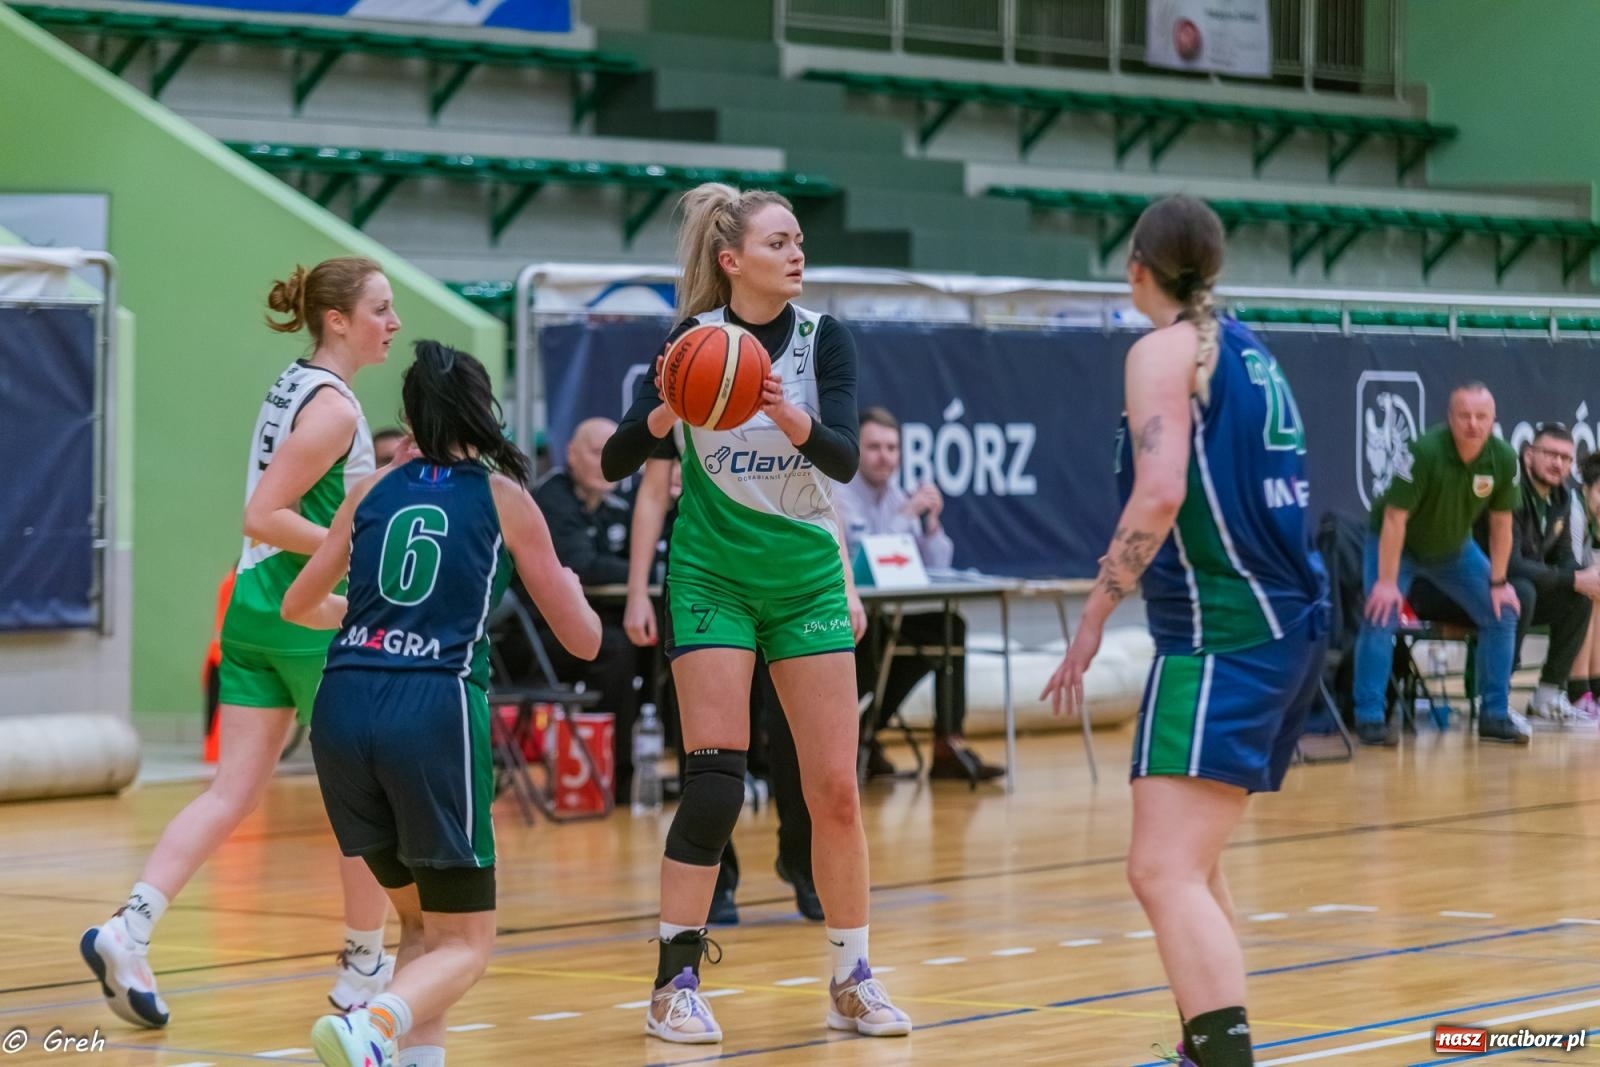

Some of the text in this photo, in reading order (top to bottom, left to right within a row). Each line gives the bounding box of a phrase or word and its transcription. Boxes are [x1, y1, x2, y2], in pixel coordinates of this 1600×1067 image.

[669, 341, 691, 403] molten
[793, 344, 811, 375] 7
[730, 450, 813, 473] Clavis
[378, 504, 449, 606] 6
[691, 602, 719, 634] 7
